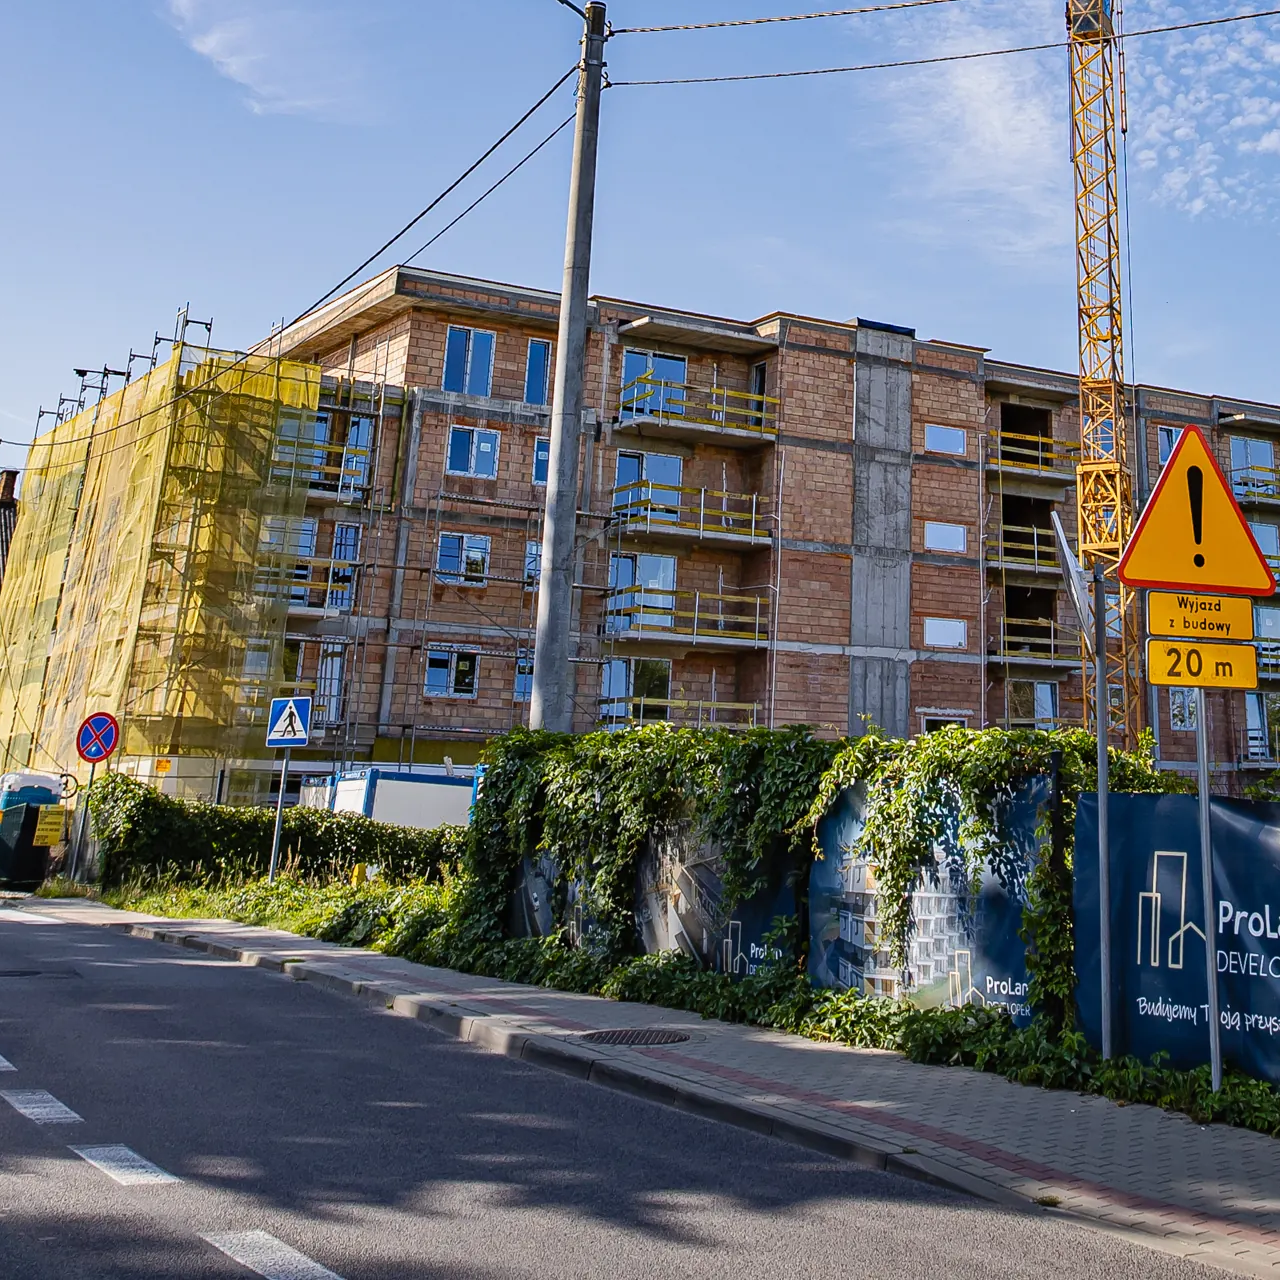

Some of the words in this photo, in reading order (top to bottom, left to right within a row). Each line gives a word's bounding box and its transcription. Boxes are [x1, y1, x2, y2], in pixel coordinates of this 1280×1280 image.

[1176, 595, 1222, 614] Wyjazd
[1169, 618, 1175, 628] z
[1183, 615, 1231, 637] budowy
[1166, 647, 1203, 678] 20
[1215, 661, 1233, 677] m
[1136, 996, 1198, 1026] Budujemy
[1199, 1004, 1241, 1031] Toją
